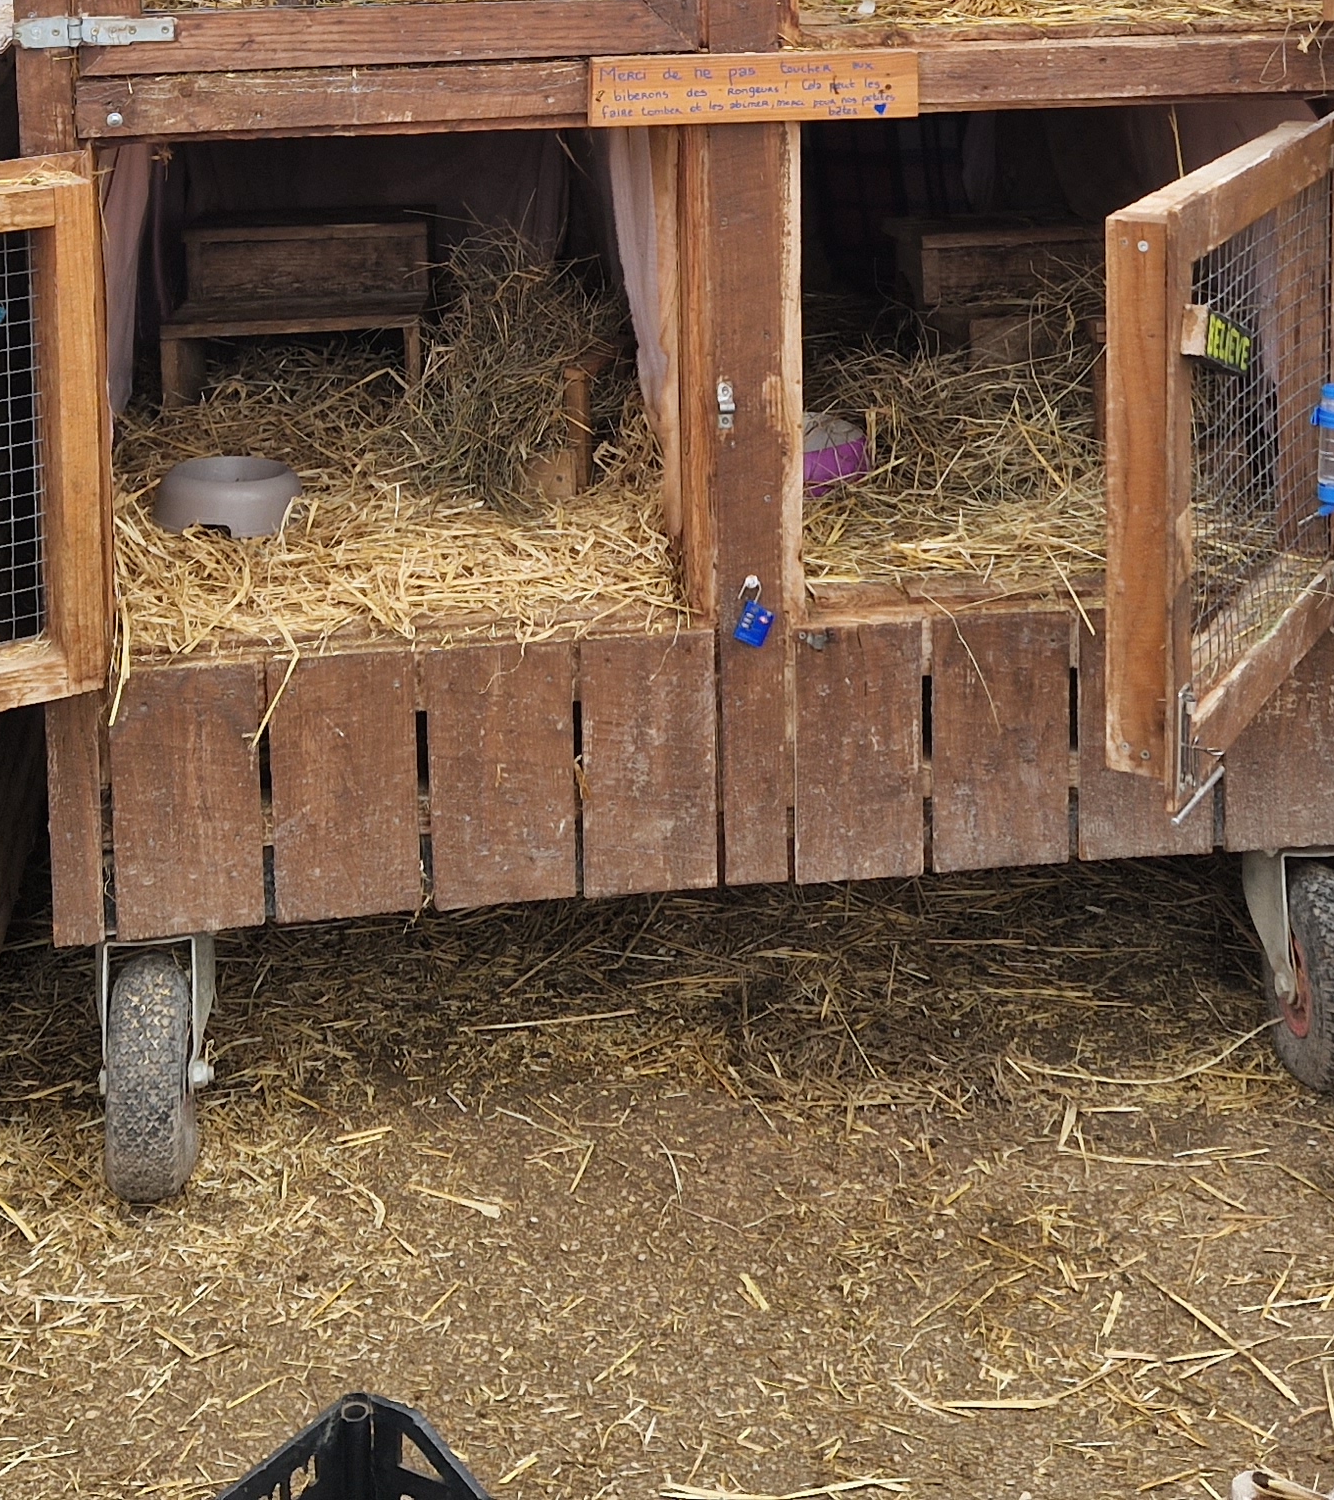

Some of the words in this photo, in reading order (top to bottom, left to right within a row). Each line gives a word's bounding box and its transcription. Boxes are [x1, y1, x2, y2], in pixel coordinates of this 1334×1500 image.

[662, 68, 682, 81] de
[694, 67, 713, 79] ne
[728, 67, 756, 86] pas
[686, 88, 708, 98] des
[864, 78, 881, 89] les
[708, 100, 724, 111] les
